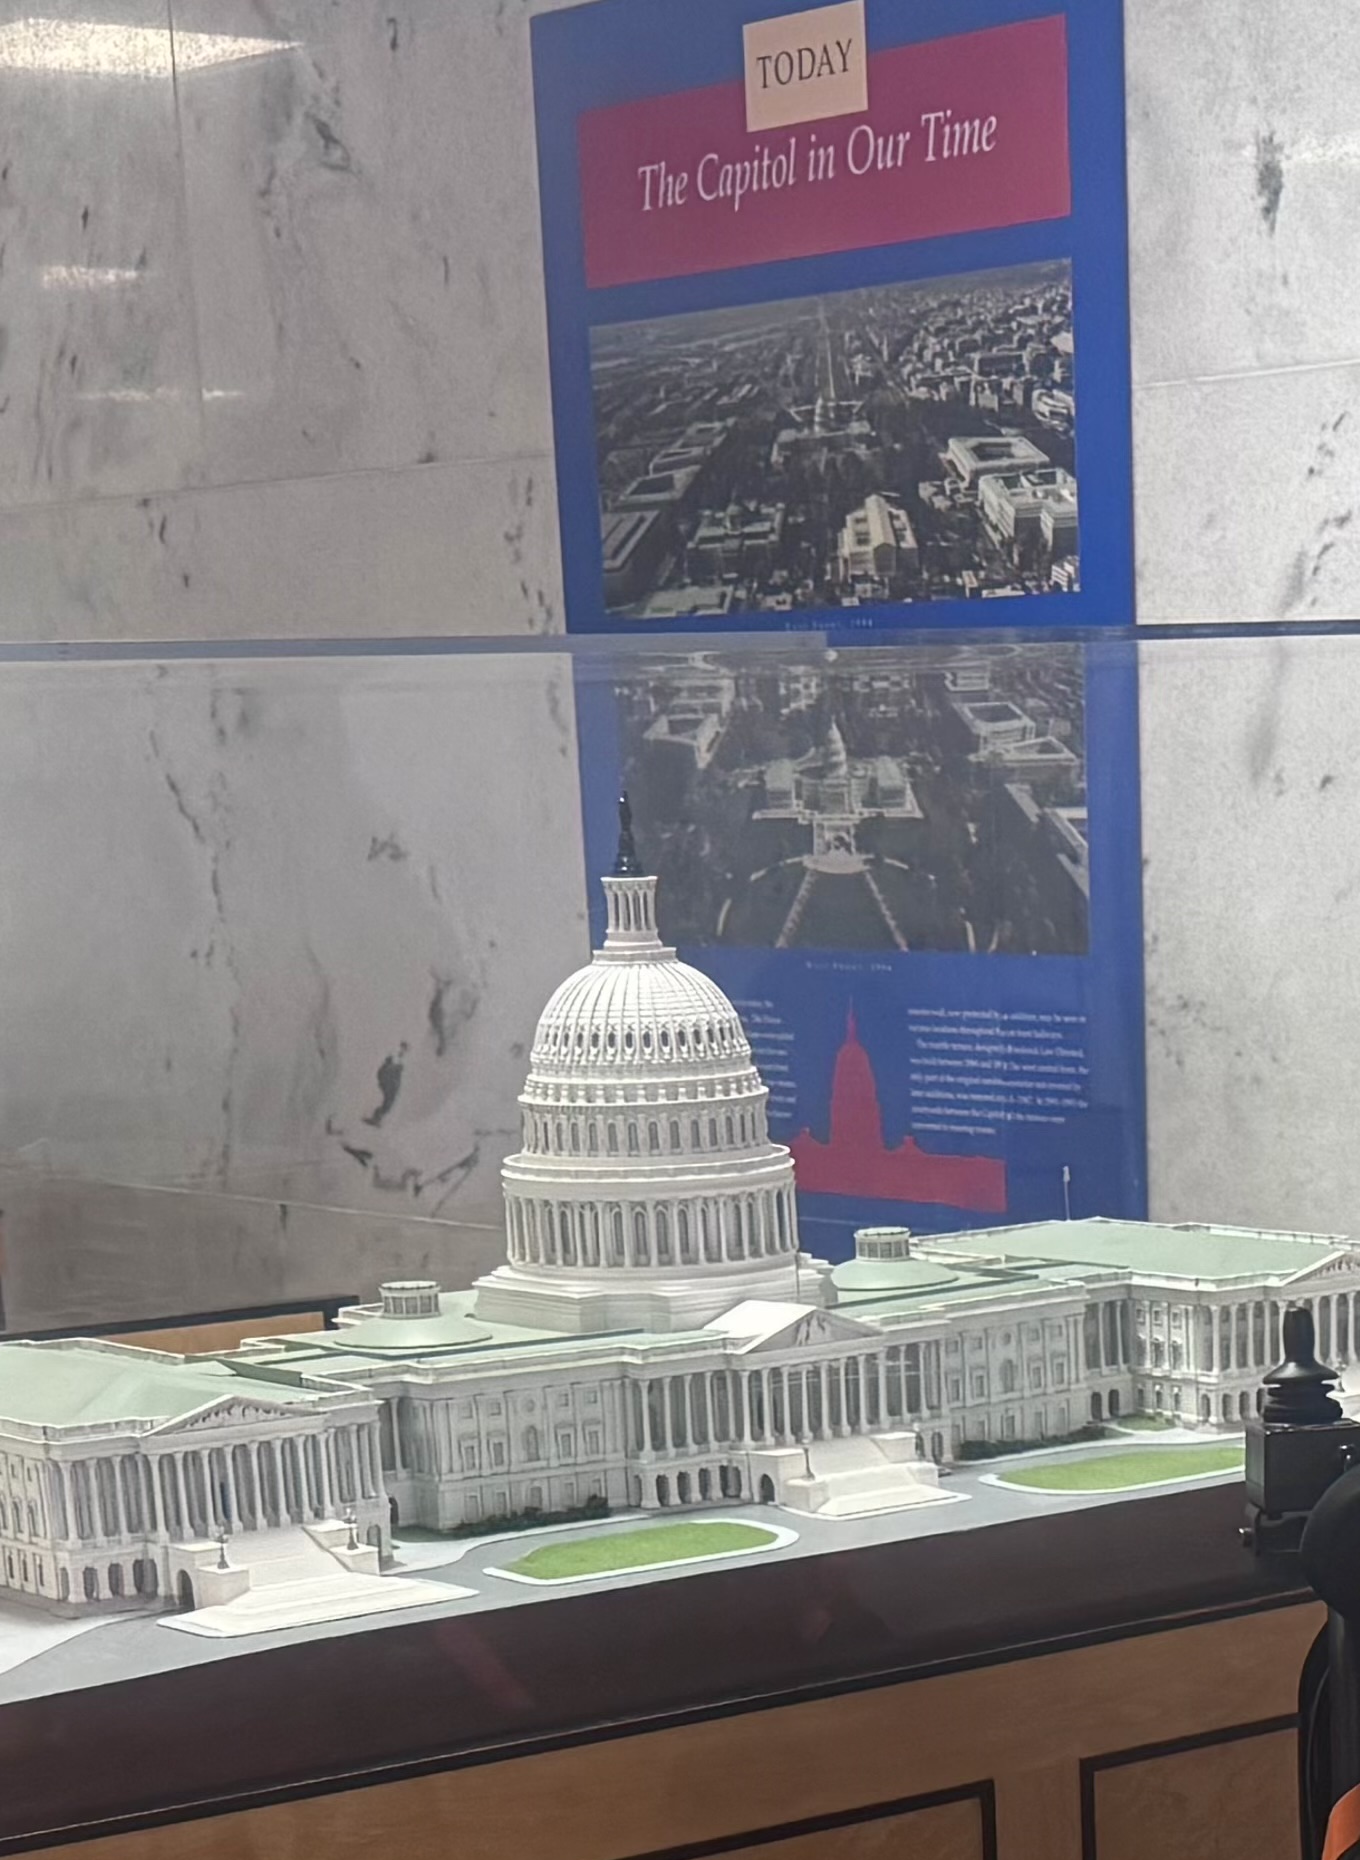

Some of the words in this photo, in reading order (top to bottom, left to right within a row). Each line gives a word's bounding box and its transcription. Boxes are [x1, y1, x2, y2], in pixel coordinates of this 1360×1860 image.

[756, 38, 853, 89] TODAY
[638, 161, 688, 211] The
[696, 137, 796, 212] Capitol
[807, 133, 836, 181] in
[846, 124, 911, 175] Our
[920, 109, 998, 163] Time
